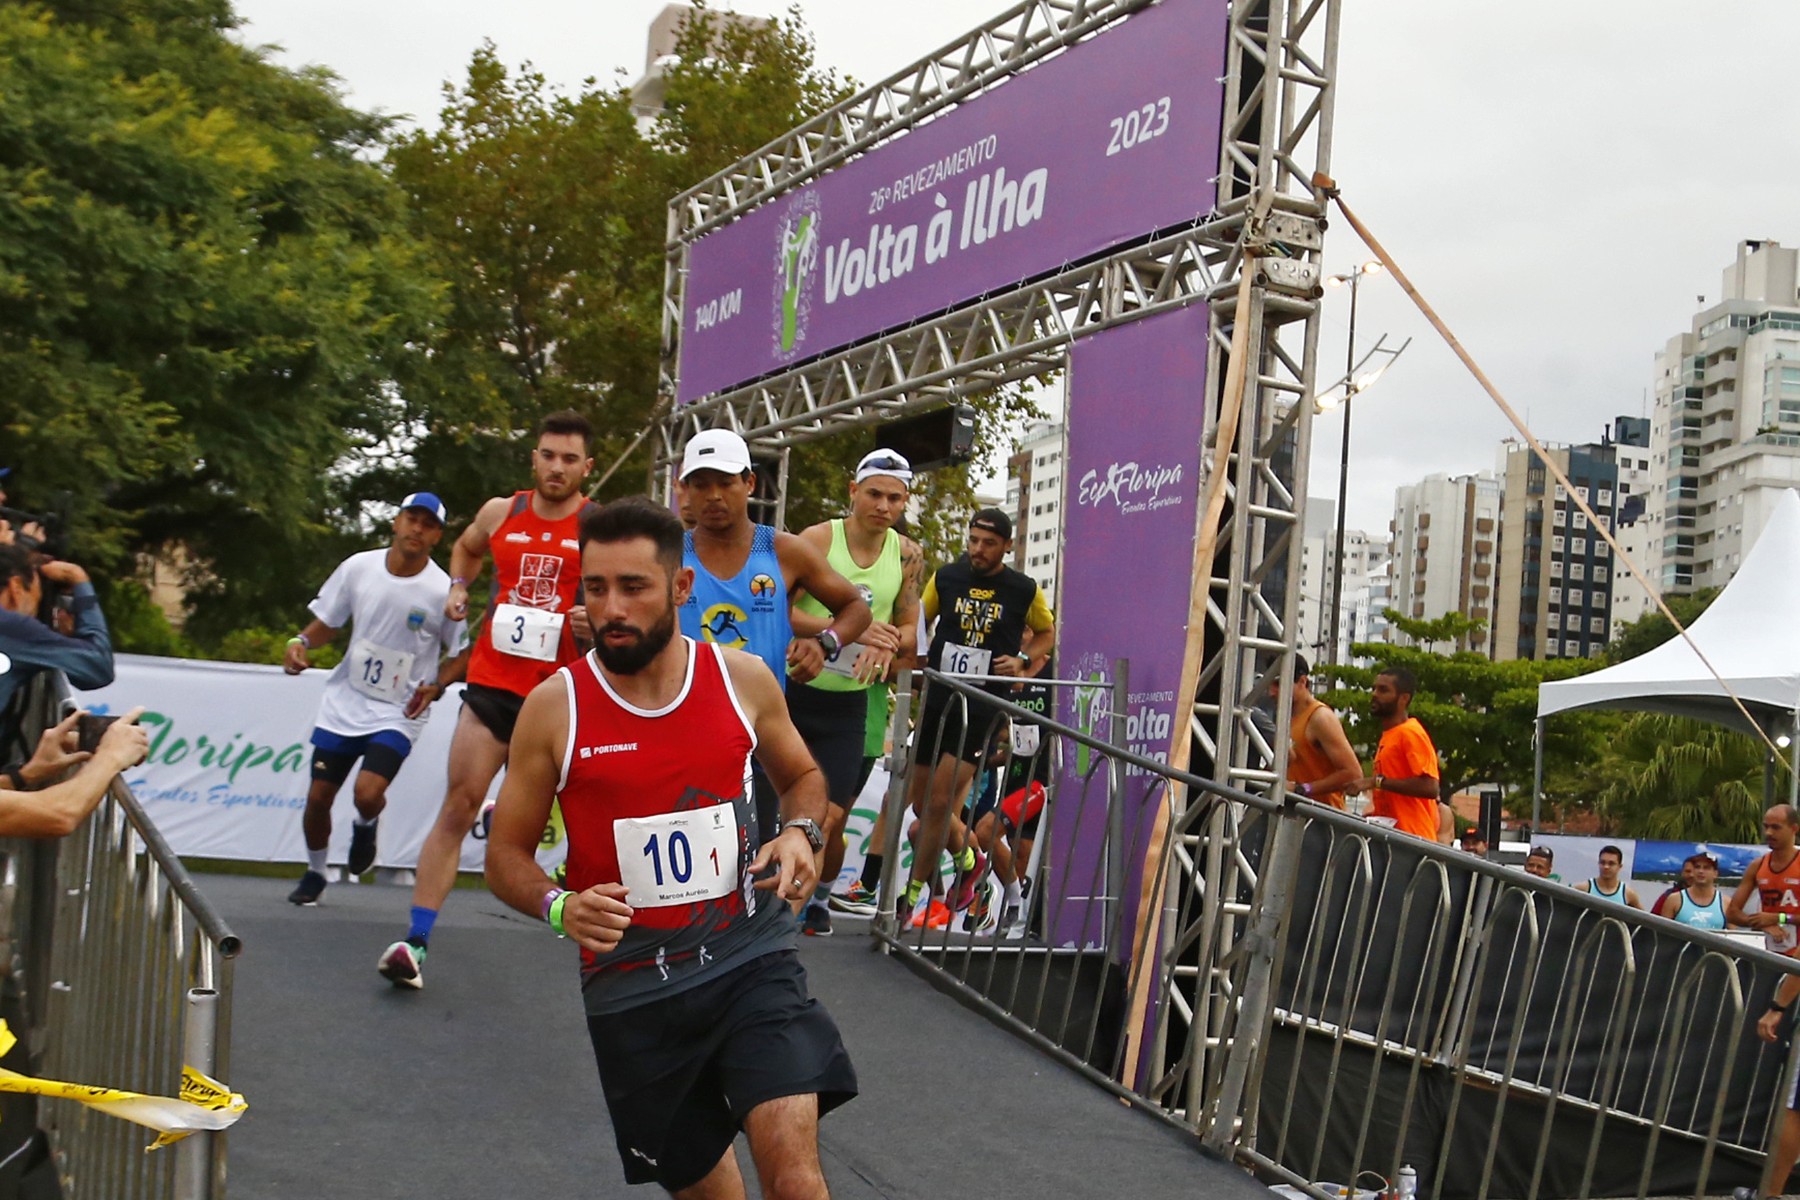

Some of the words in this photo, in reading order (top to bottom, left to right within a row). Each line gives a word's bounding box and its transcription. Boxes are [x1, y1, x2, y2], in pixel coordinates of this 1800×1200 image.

[1106, 96, 1171, 157] 2023
[868, 186, 891, 214] 26º
[892, 134, 997, 203] REVEZAMENTO
[825, 223, 918, 304] Volta
[925, 192, 953, 265] à
[959, 166, 1048, 250] Ilha
[695, 299, 718, 332] 140
[718, 288, 742, 322] KM
[954, 597, 1003, 620] NEVER
[511, 615, 526, 644] 3
[960, 612, 994, 633] GIVE
[540, 631, 546, 648] 1
[965, 630, 985, 648] UP
[364, 657, 384, 684] 13
[950, 651, 969, 675] 16
[974, 665, 979, 675] 1
[392, 674, 399, 688] 1
[593, 742, 638, 755] PORTONAVE
[643, 830, 693, 886] 10
[709, 846, 721, 877] 1
[658, 891, 684, 901] Marcos
[685, 888, 709, 897] Aurélio
